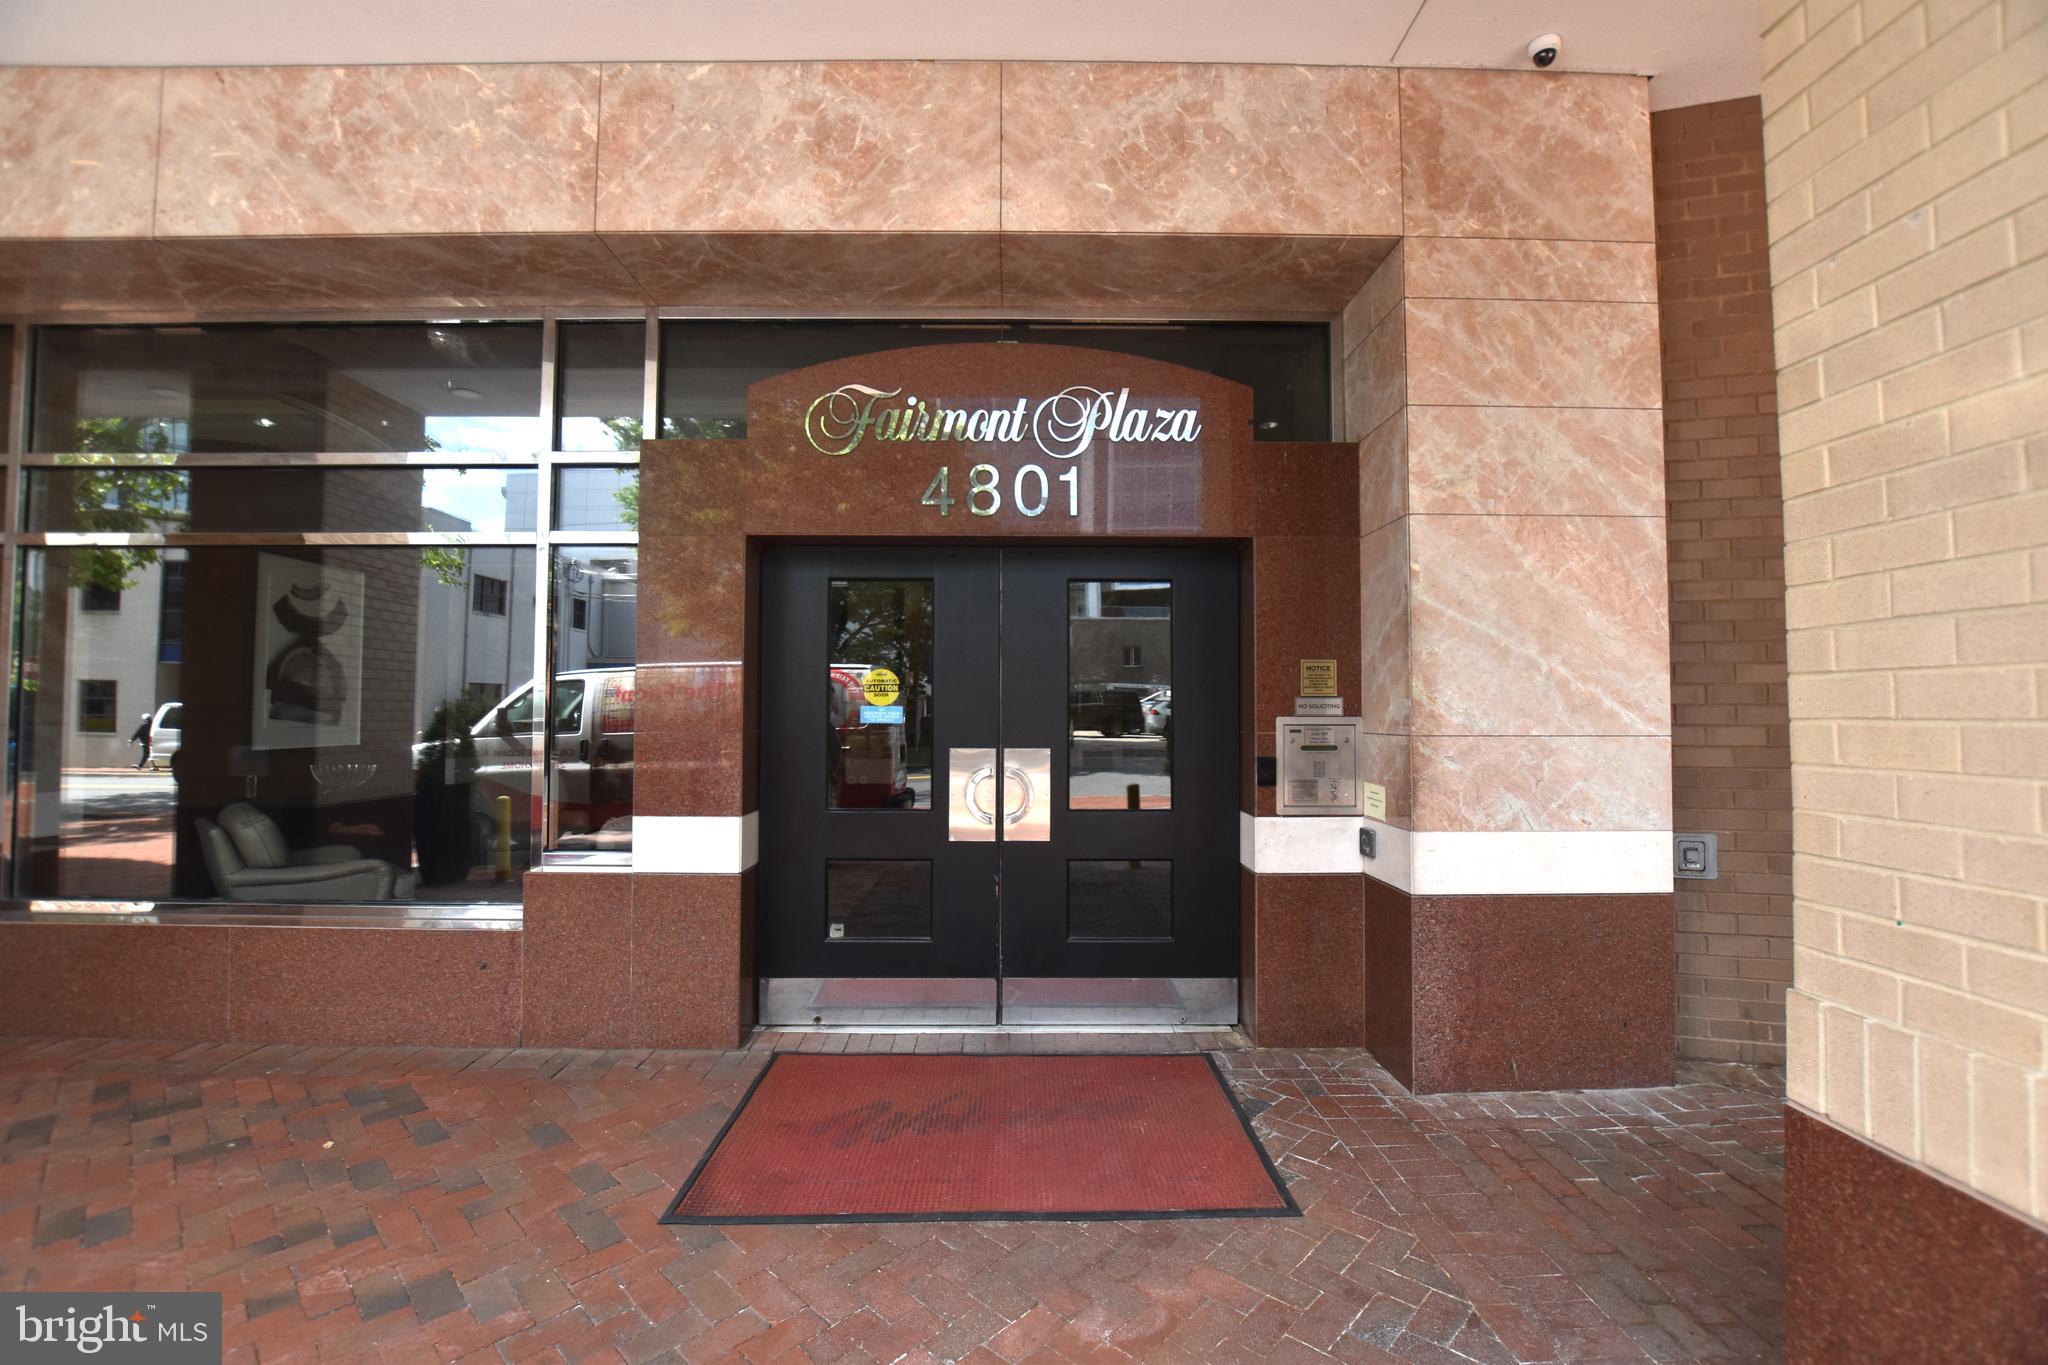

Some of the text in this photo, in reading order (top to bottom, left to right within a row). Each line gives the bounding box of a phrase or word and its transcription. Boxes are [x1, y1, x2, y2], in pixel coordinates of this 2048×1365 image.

[804, 384, 1202, 459] Fairmont Plaza
[921, 463, 1079, 517] 4801
